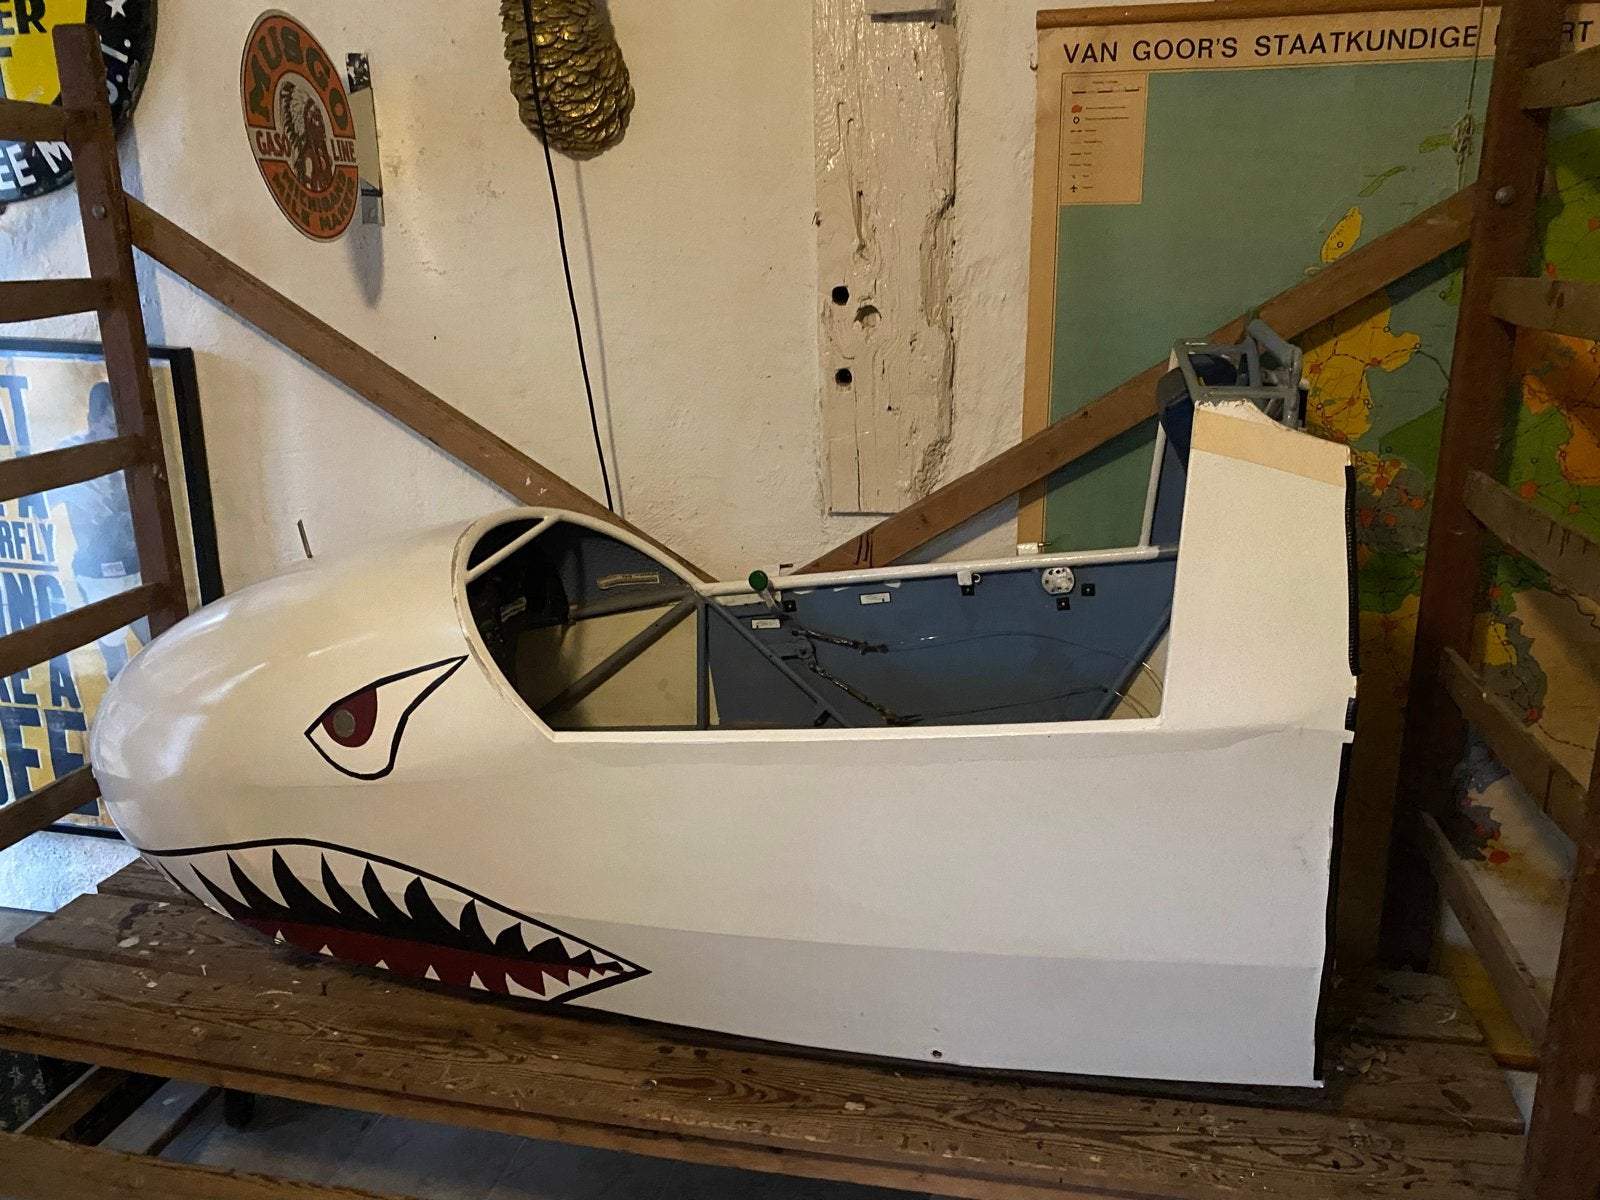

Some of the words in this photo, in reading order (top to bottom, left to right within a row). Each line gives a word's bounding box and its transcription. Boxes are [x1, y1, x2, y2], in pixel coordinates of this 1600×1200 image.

[1063, 41, 1118, 64] VAN
[1132, 36, 1238, 61] GOOR'S
[1254, 25, 1478, 57] STAATKUNDIGE
[249, 25, 349, 129] MUSGO
[330, 138, 357, 163] LINE
[0, 375, 31, 459] T
[0, 521, 56, 563] RFLY
